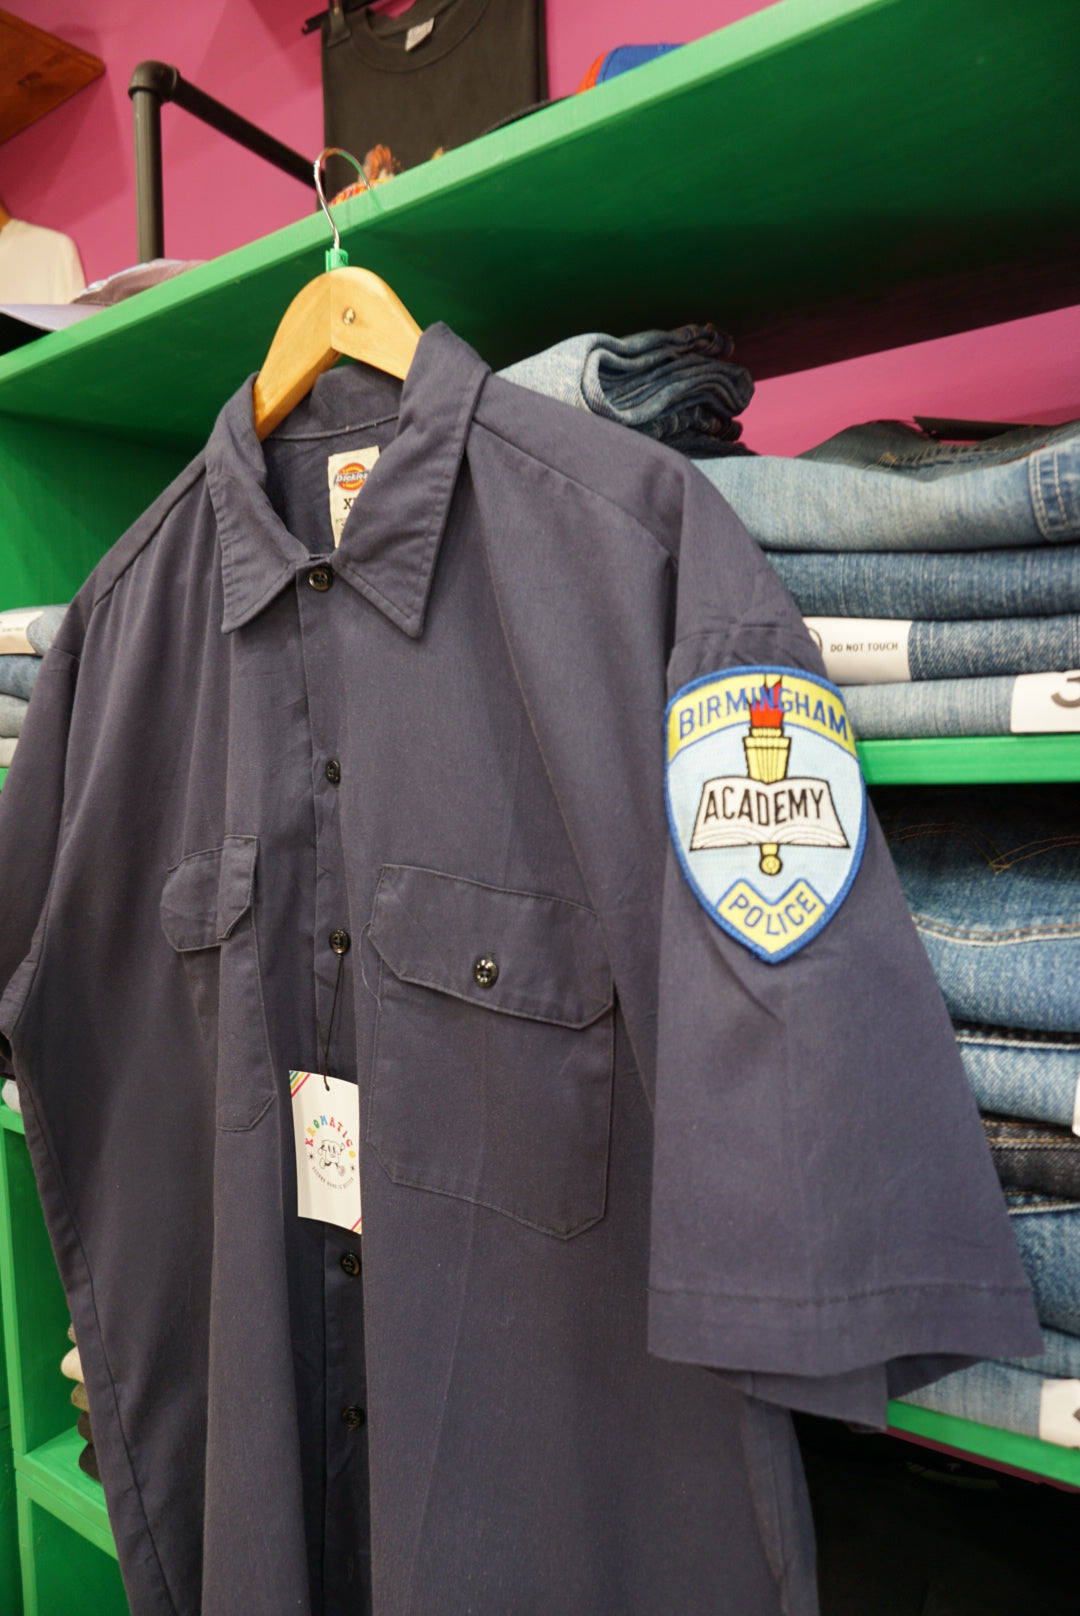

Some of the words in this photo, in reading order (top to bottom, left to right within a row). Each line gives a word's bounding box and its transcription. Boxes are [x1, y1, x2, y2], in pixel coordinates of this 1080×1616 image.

[830, 643, 843, 653] DO
[846, 643, 863, 652] NOT
[868, 642, 898, 652] TOUCH
[679, 685, 848, 741] BIRMINGHAM
[703, 786, 824, 826] ACADEMY
[728, 891, 817, 935] POLICE
